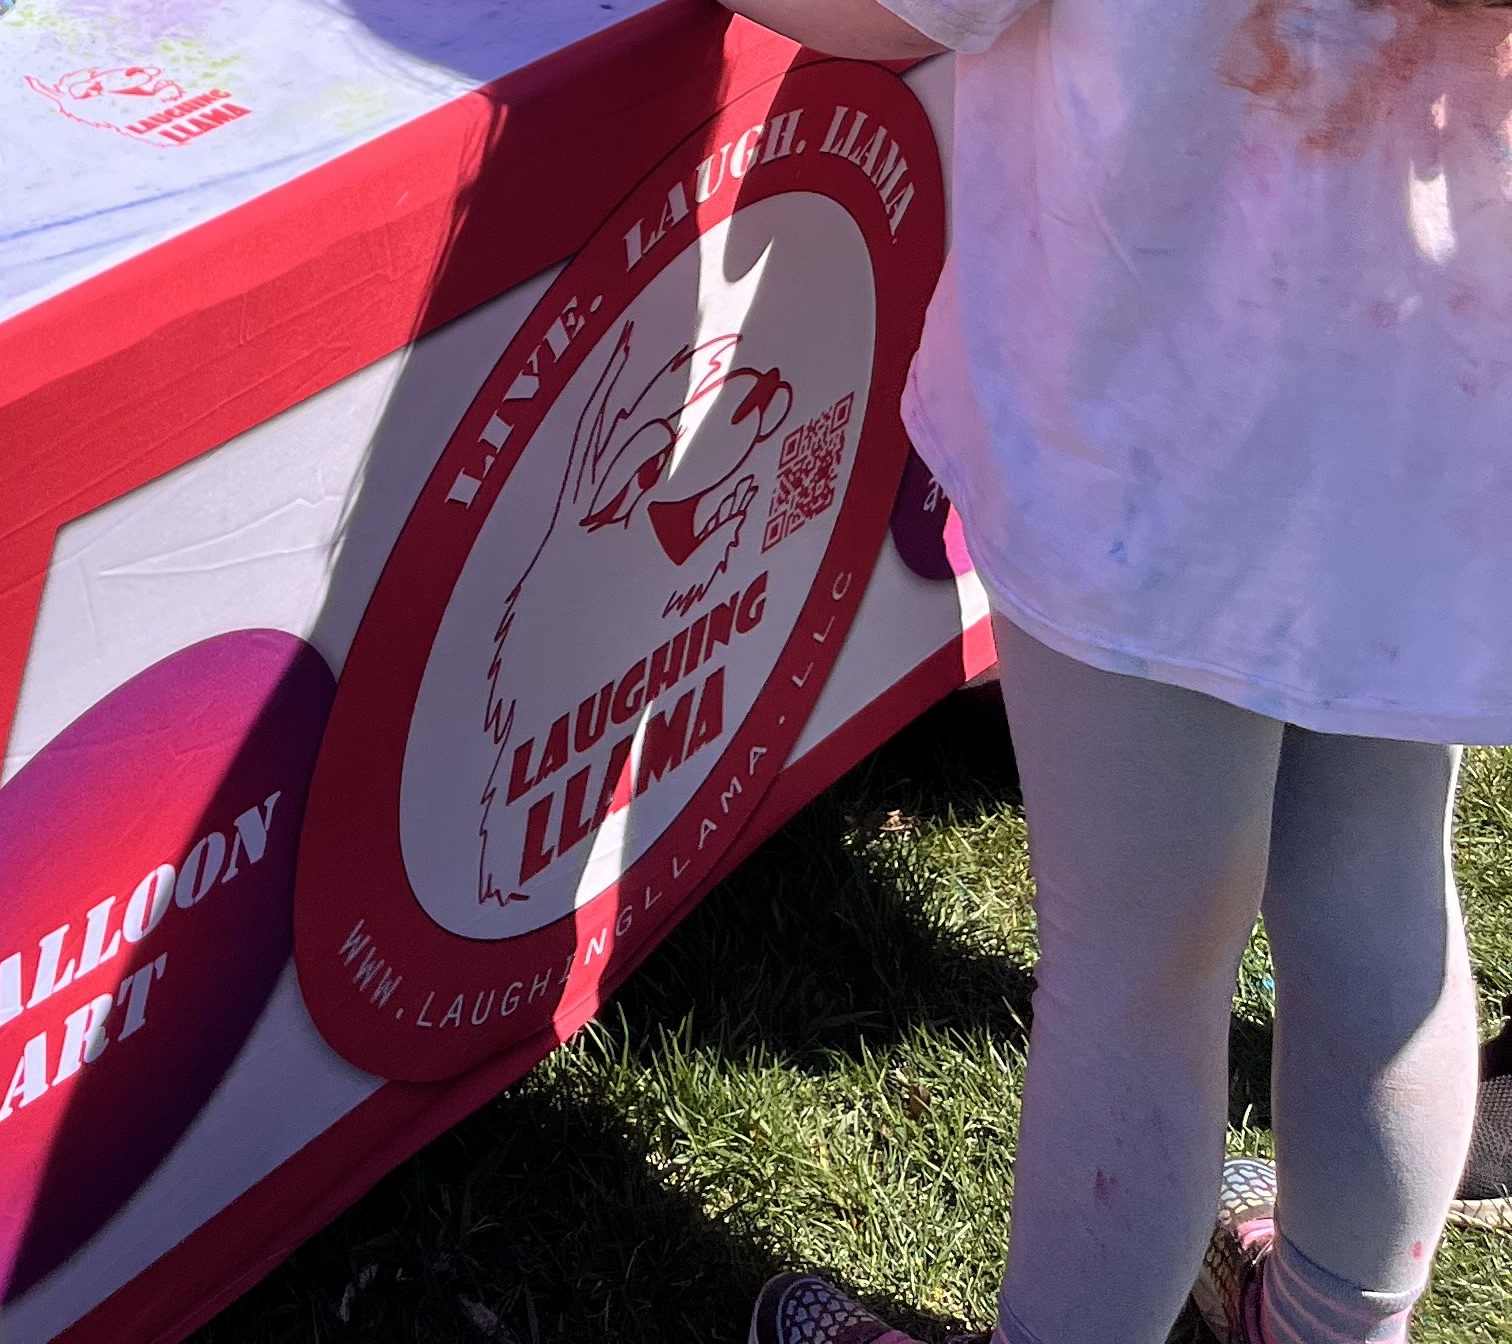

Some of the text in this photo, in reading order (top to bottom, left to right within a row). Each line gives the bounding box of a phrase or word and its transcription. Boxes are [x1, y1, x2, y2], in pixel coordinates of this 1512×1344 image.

[125, 89, 232, 134] LAUGHING
[158, 103, 252, 144] LLAMA
[445, 294, 603, 509] LIVE.
[623, 108, 805, 272] LAUGH.
[338, 570, 853, 1029] WWW.LAUGHINGLLAMA.LLC
[505, 571, 768, 807] LAUGHING
[517, 665, 726, 887] LLAMA
